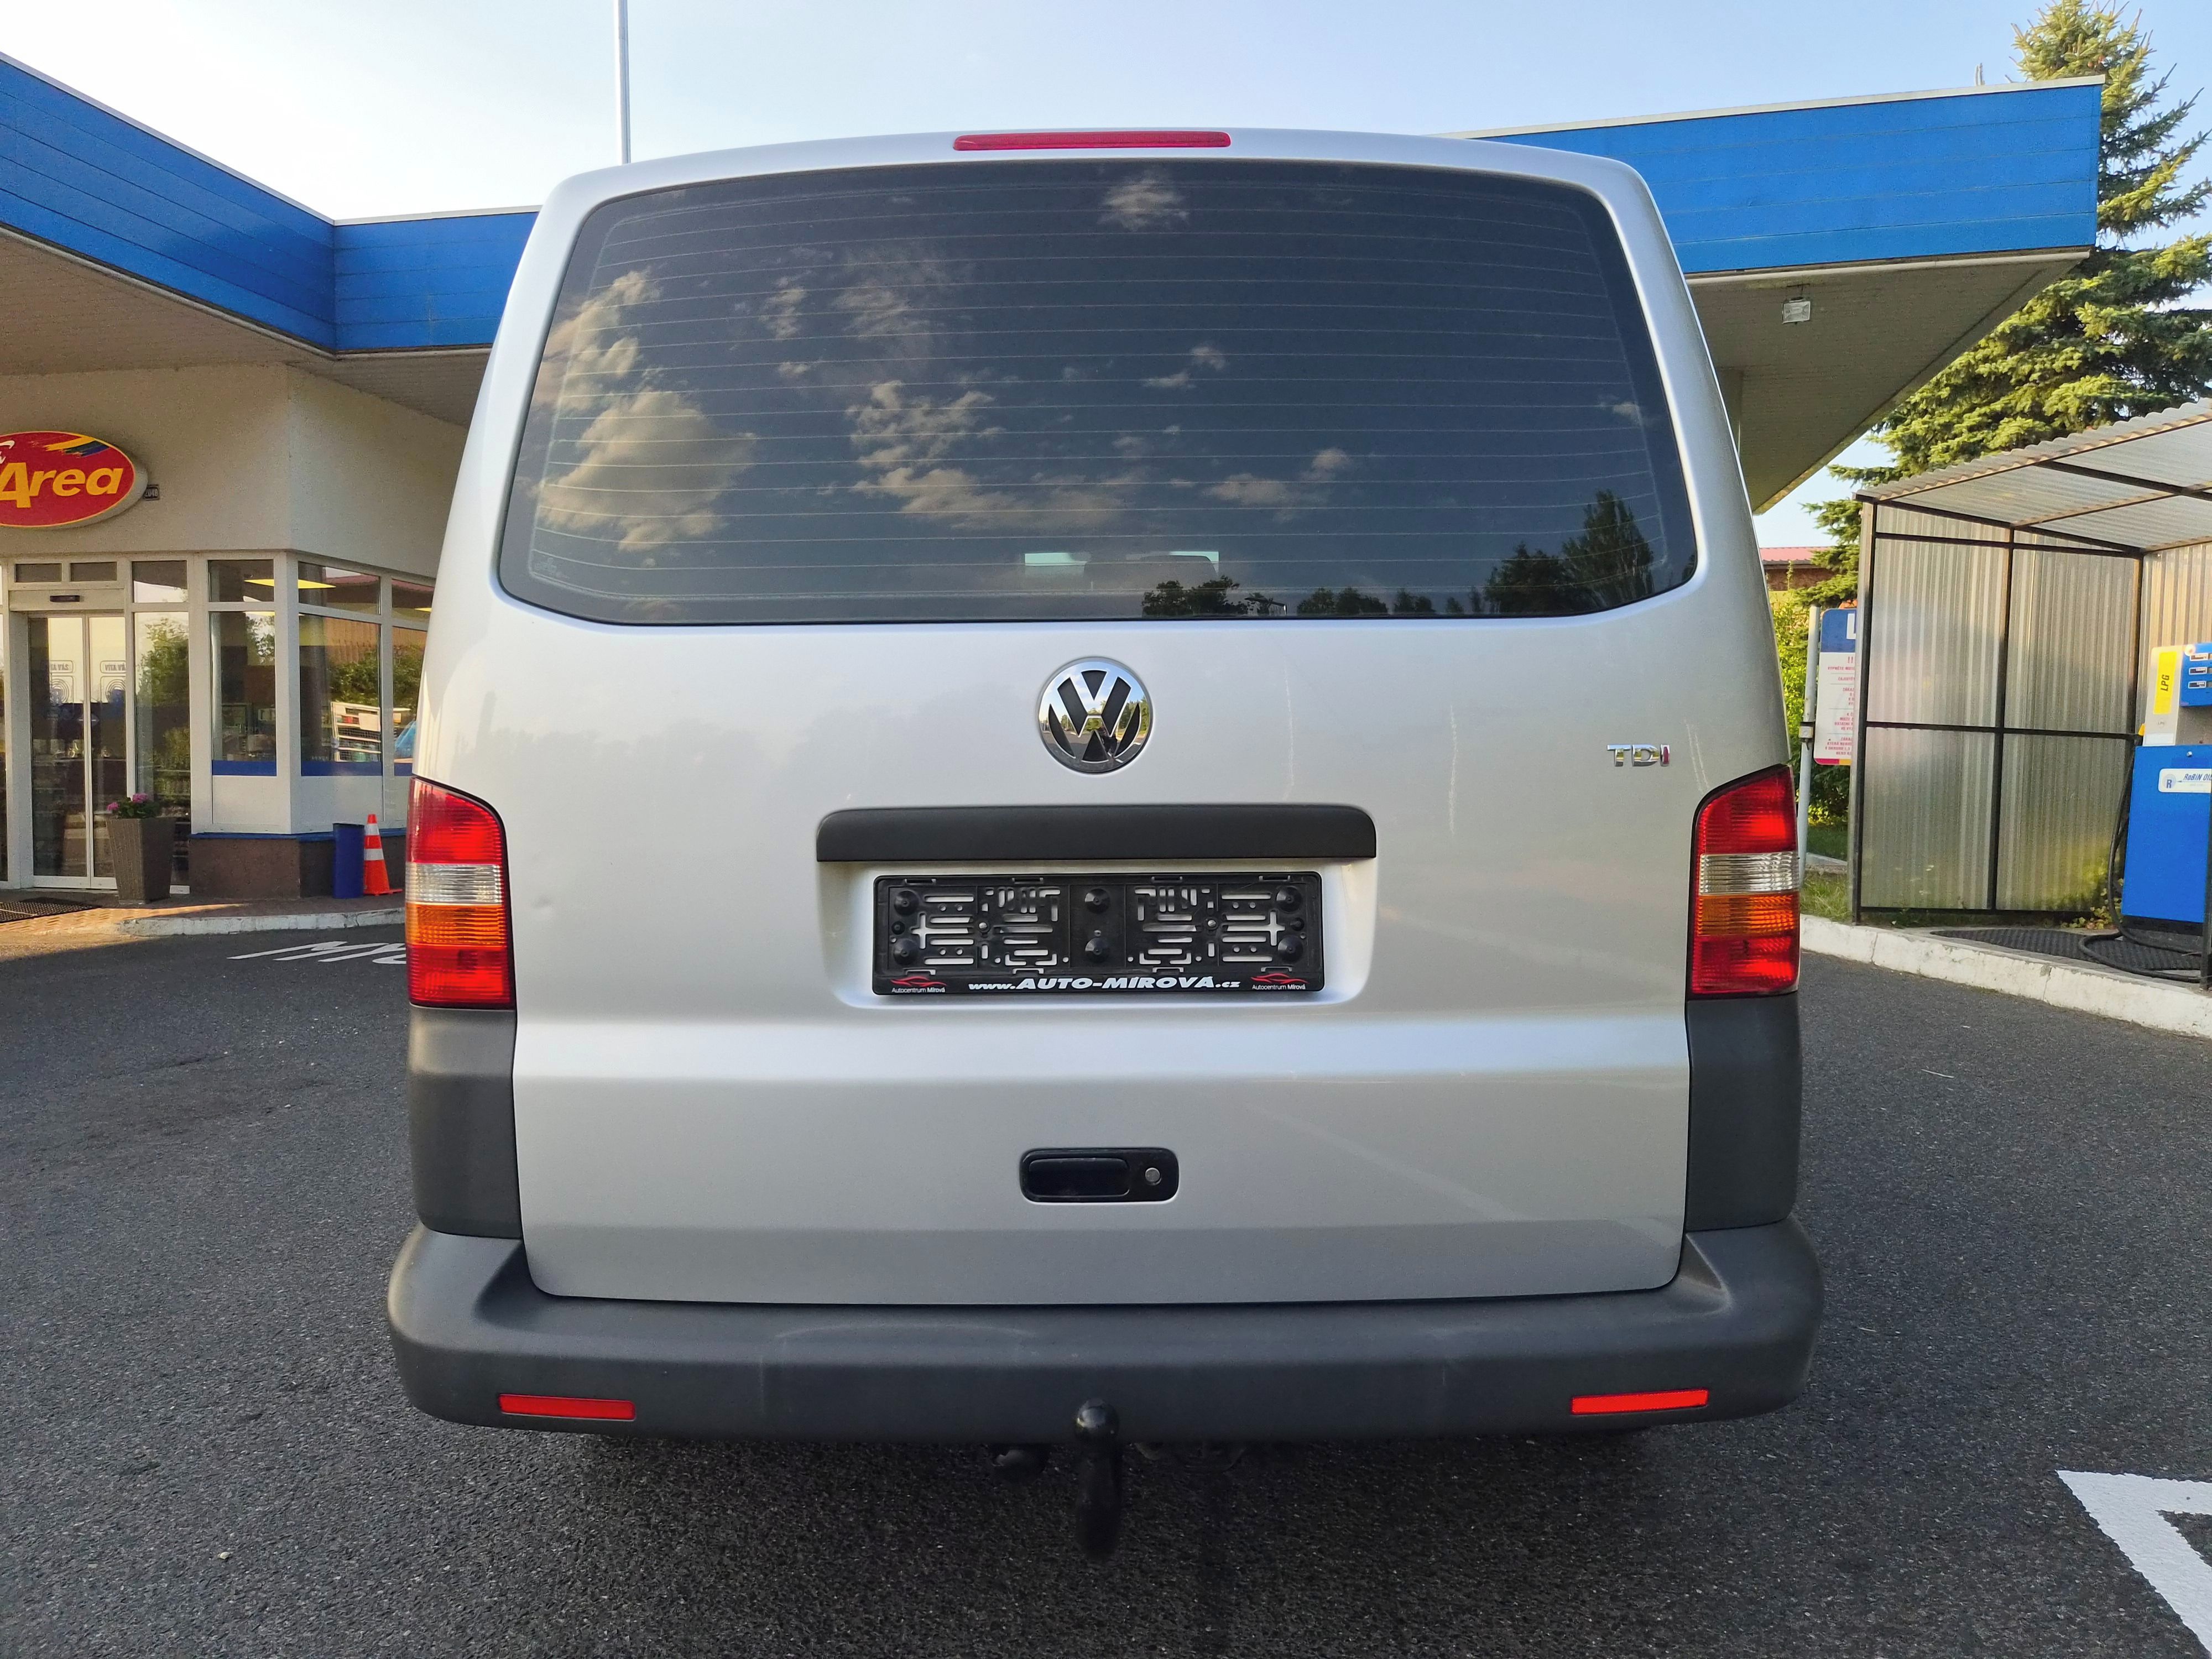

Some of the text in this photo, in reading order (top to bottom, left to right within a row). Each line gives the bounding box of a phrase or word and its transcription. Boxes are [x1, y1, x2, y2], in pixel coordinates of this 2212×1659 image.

[2161, 674, 2169, 691] LPG
[1040, 660, 1151, 770] VW
[1606, 744, 1670, 767] TDI
